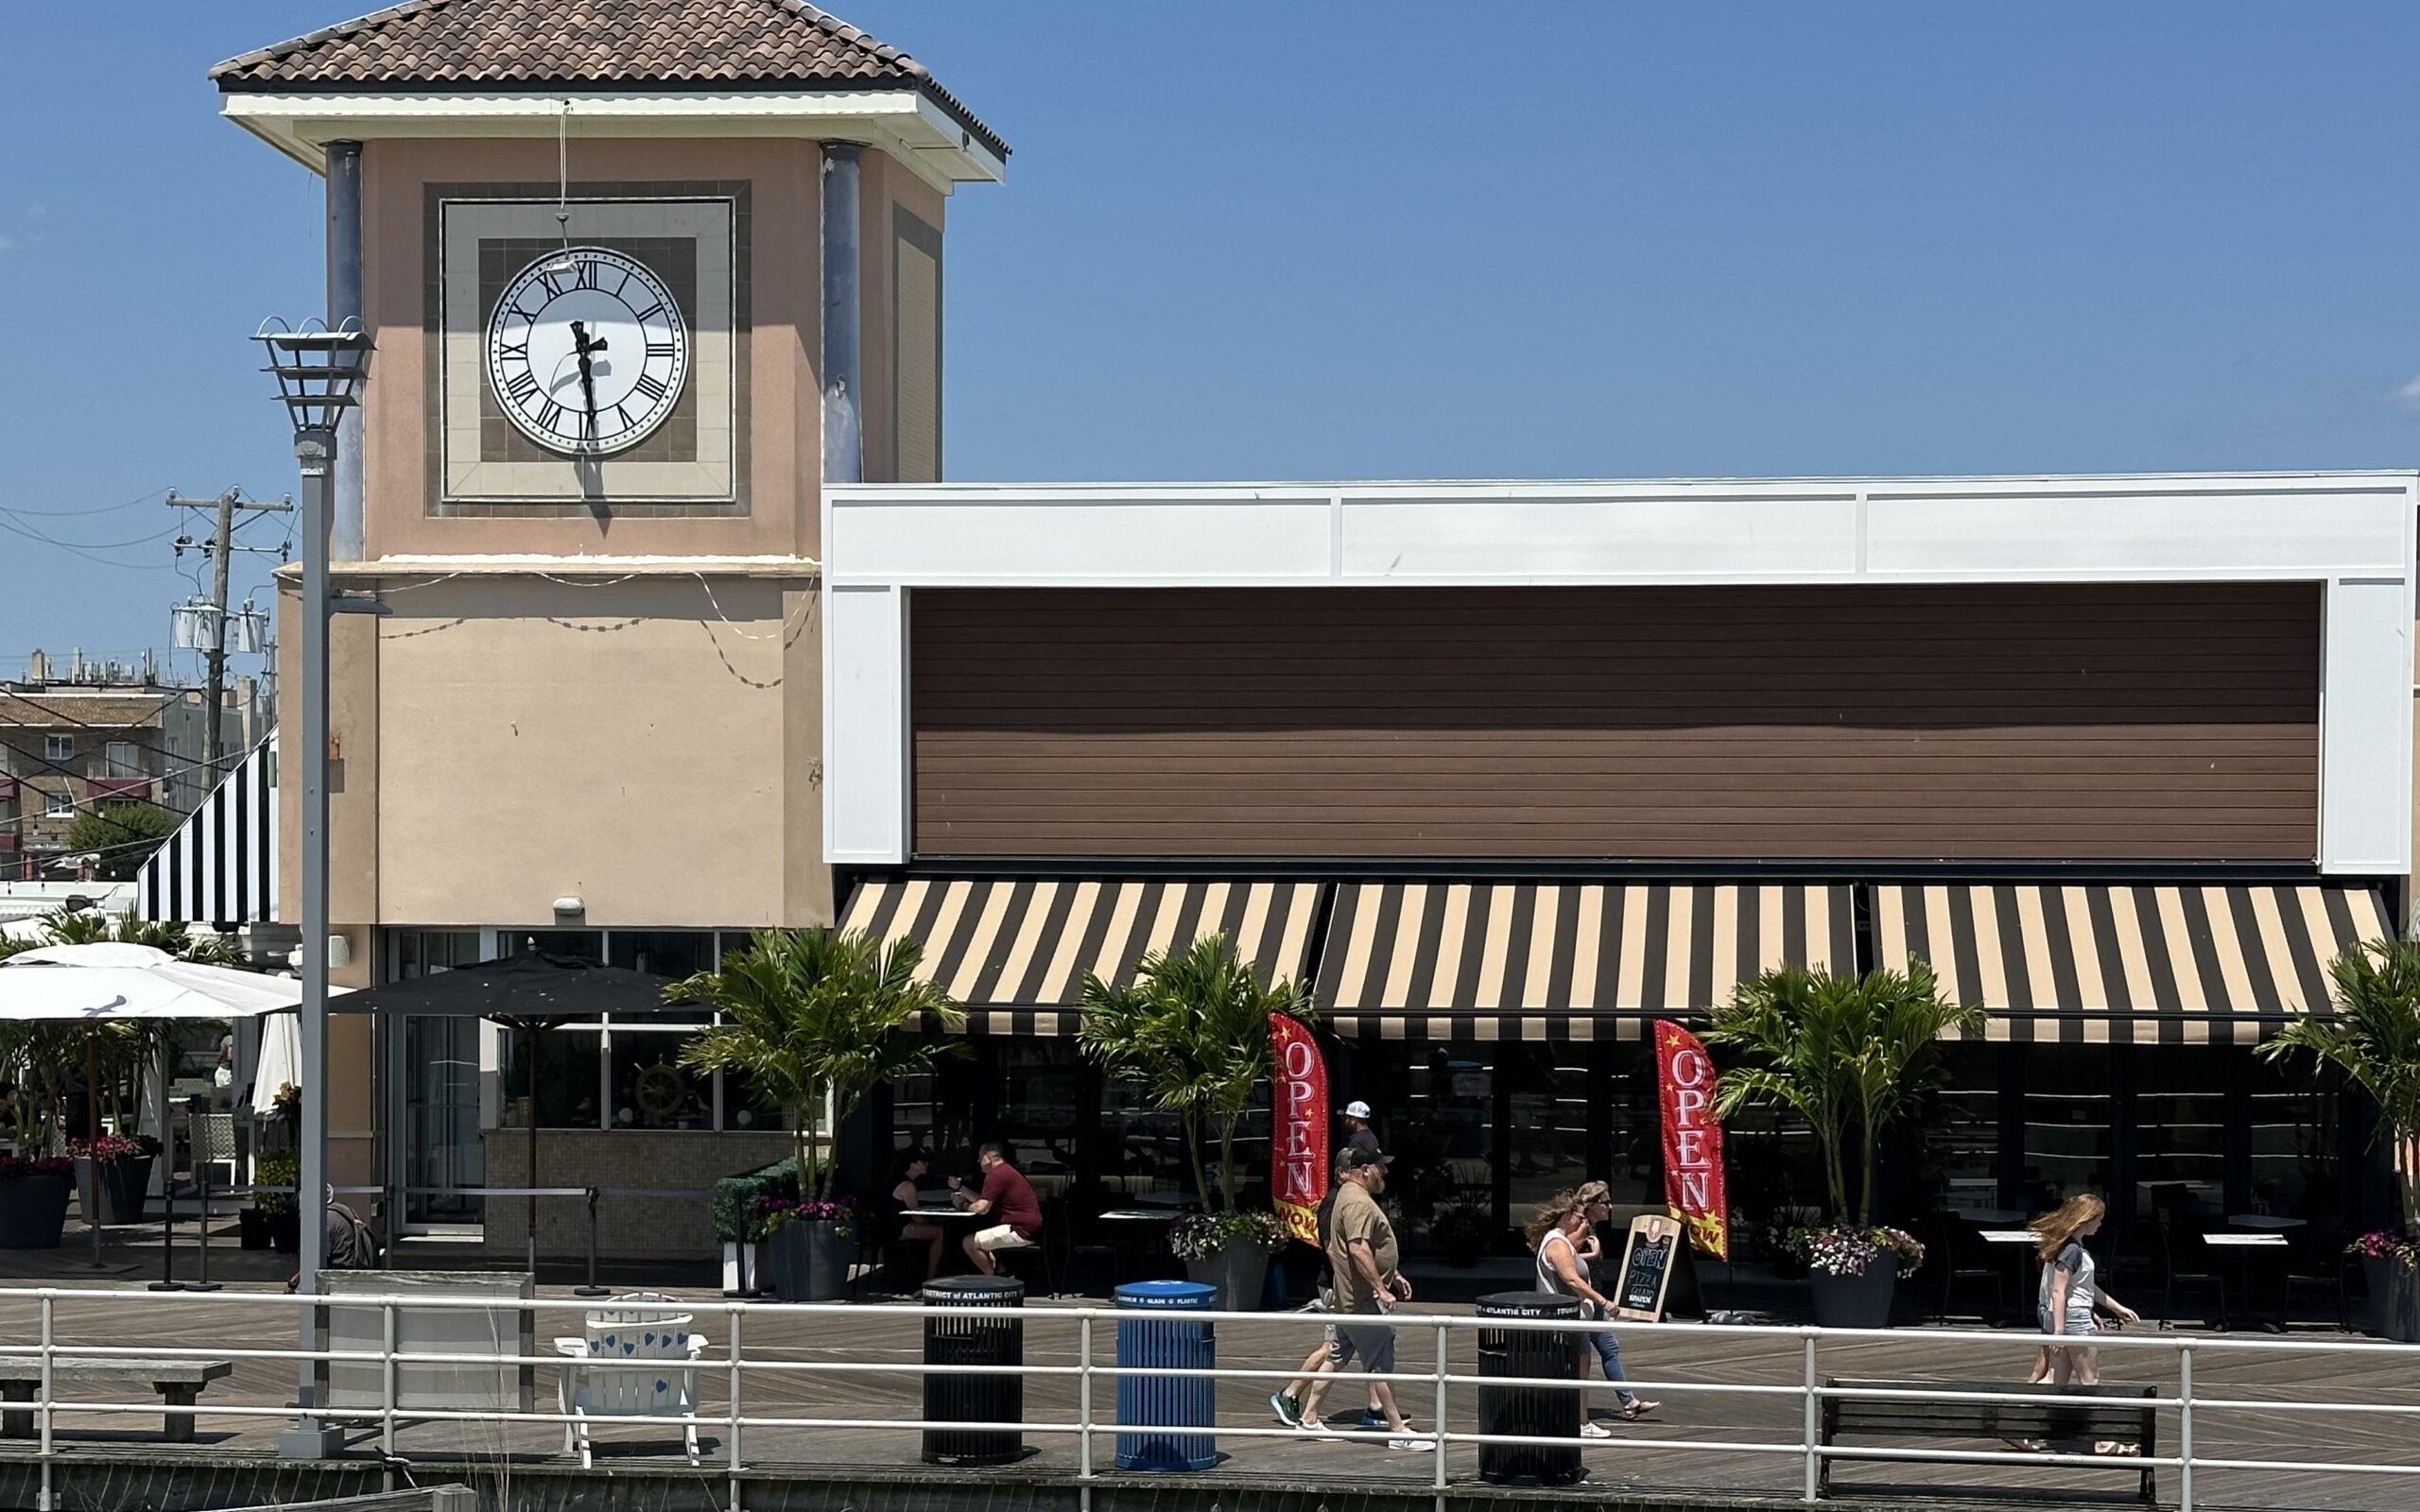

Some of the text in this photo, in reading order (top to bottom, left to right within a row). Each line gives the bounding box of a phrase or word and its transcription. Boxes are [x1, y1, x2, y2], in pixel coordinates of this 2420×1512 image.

[576, 261, 597, 289] XII
[509, 302, 537, 325] X
[637, 302, 664, 322] II
[500, 343, 527, 360] IX
[647, 343, 675, 357] III
[616, 404, 636, 430] V
[1284, 1041, 1315, 1200] OPEN
[1671, 1049, 1712, 1211] OPEN
[1278, 1207, 1319, 1232] NOW
[1633, 1247, 1668, 1269] OPEN
[1628, 1269, 1657, 1289] PIZZA
[1486, 1307, 1520, 1315] ATLANTIC
